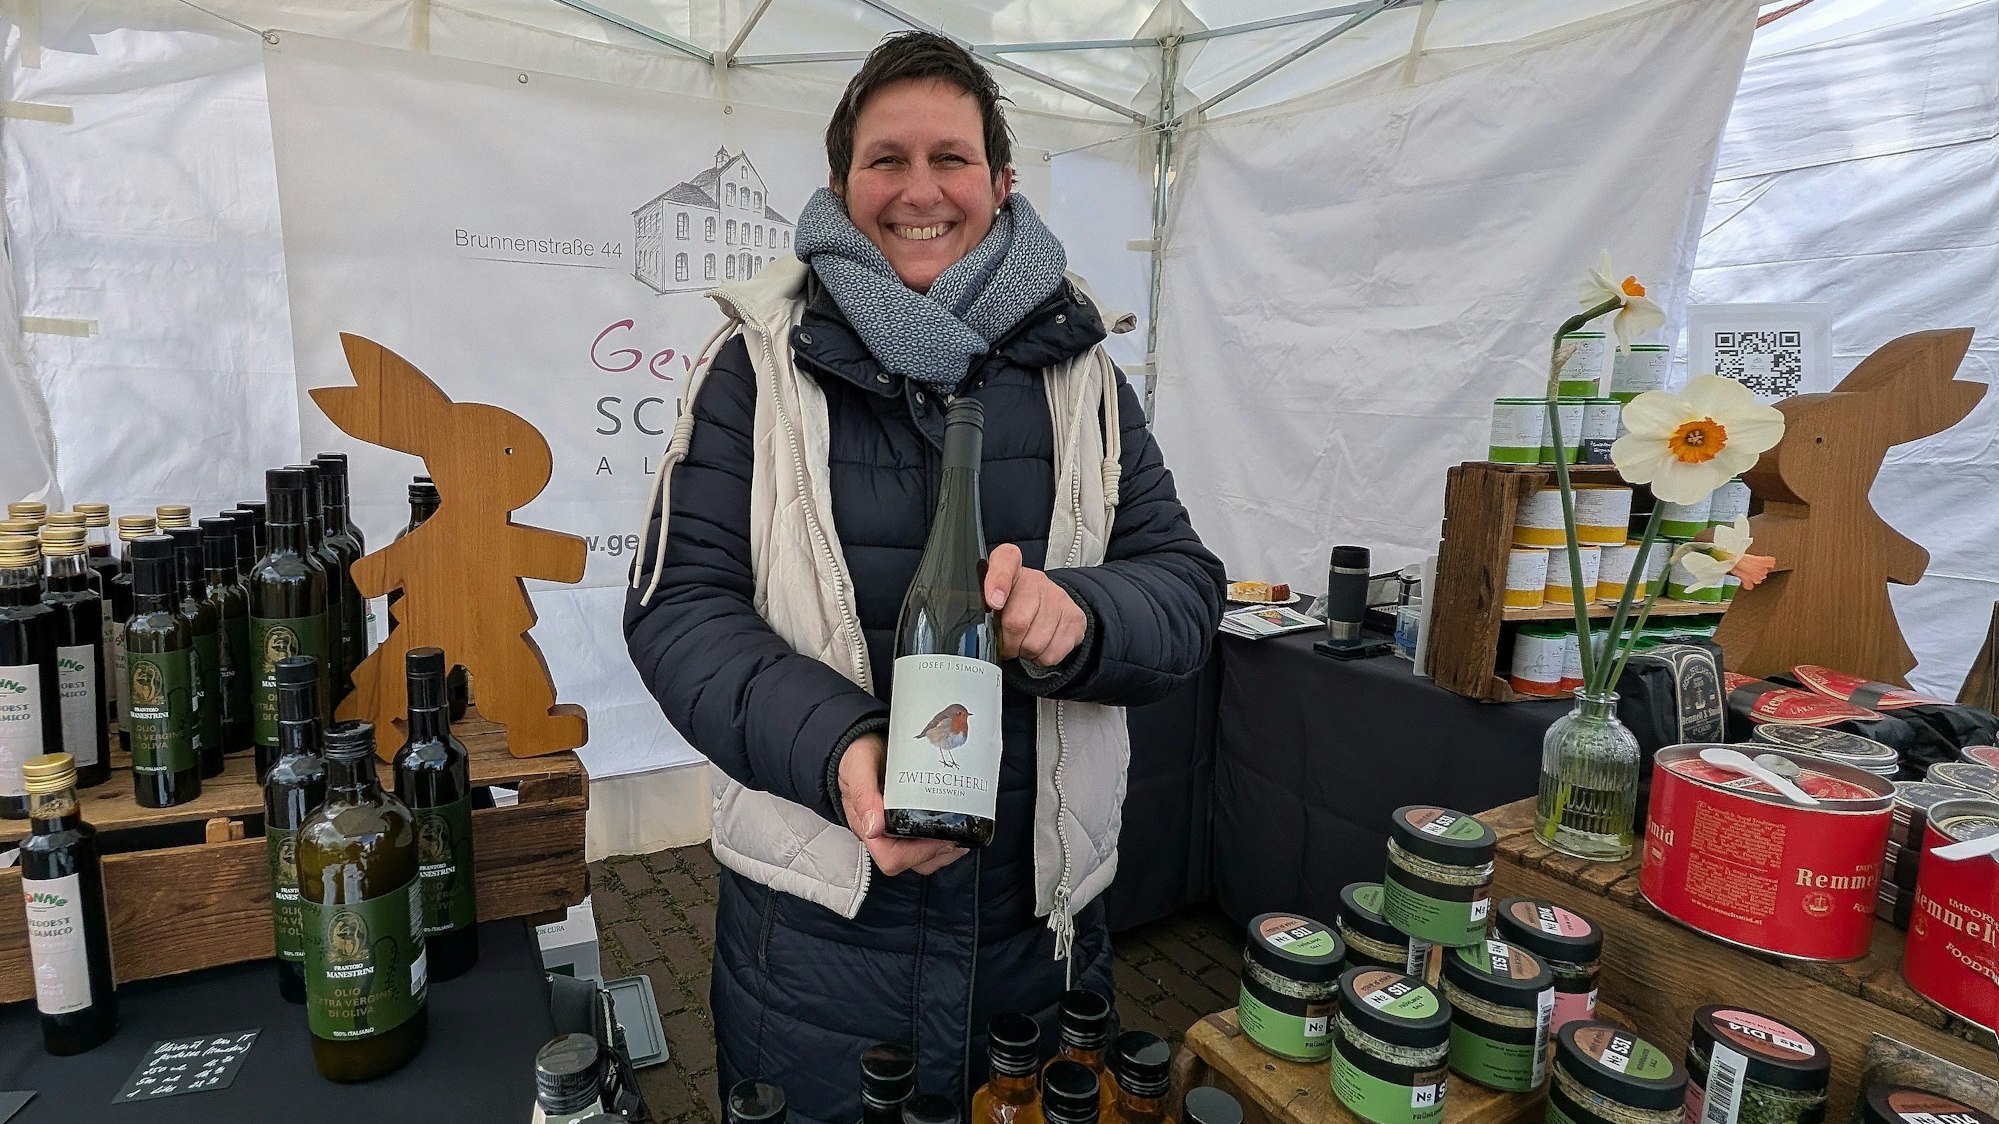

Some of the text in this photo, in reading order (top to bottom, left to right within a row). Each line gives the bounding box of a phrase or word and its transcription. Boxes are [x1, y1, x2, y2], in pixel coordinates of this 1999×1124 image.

[454, 229, 623, 258] Brunnenstraße 44
[595, 396, 682, 436] SC
[918, 661, 985, 675] JOSEF J. SIMON
[924, 786, 966, 797] WEISSWEIN
[326, 966, 375, 979] MANESTRINI
[333, 962, 364, 971] FRANTOIO
[334, 987, 361, 997] OLIO
[341, 1006, 375, 1018] OLIVA
[347, 1027, 375, 1037] ITALIANO
